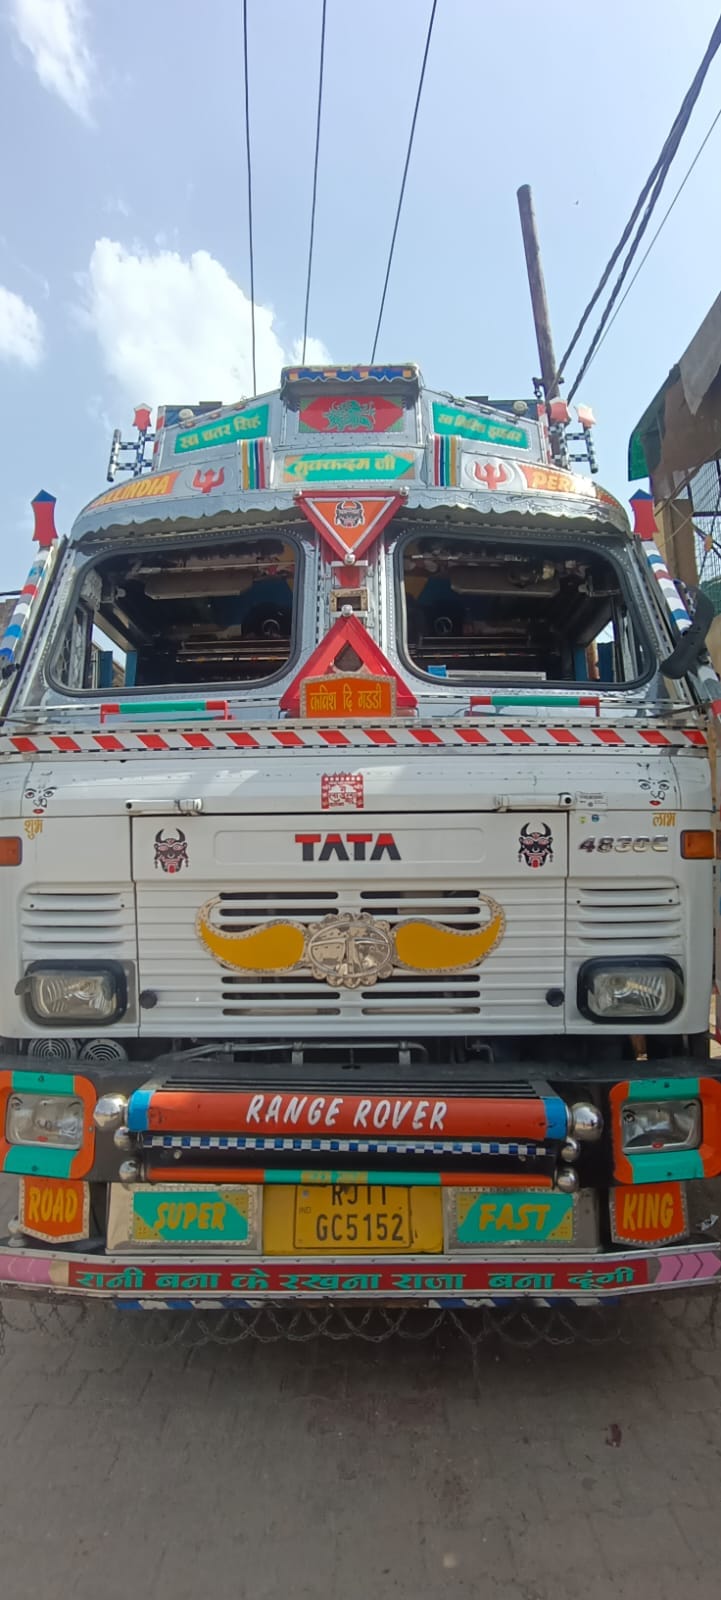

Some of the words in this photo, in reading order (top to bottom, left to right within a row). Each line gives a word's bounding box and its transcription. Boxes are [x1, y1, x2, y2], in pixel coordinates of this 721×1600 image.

[24, 818, 43, 840] शुभ
[652, 812, 676, 828] लाभ
[295, 833, 402, 862] TATA
[578, 835, 669, 853] 4830C
[246, 1094, 343, 1127] RANGE
[353, 1098, 448, 1131] ROVER
[28, 1186, 78, 1224] ROAD
[154, 1201, 227, 1231] SUPER
[478, 1203, 551, 1232] FAST
[622, 1192, 675, 1231] KING
[316, 1214, 404, 1242] GC5152
[76, 1267, 146, 1289] रानी
[155, 1272, 222, 1289] बना
[231, 1268, 270, 1290] के
[279, 1273, 382, 1290] रखना
[391, 1273, 467, 1290] राजा
[488, 1273, 556, 1289] बना
